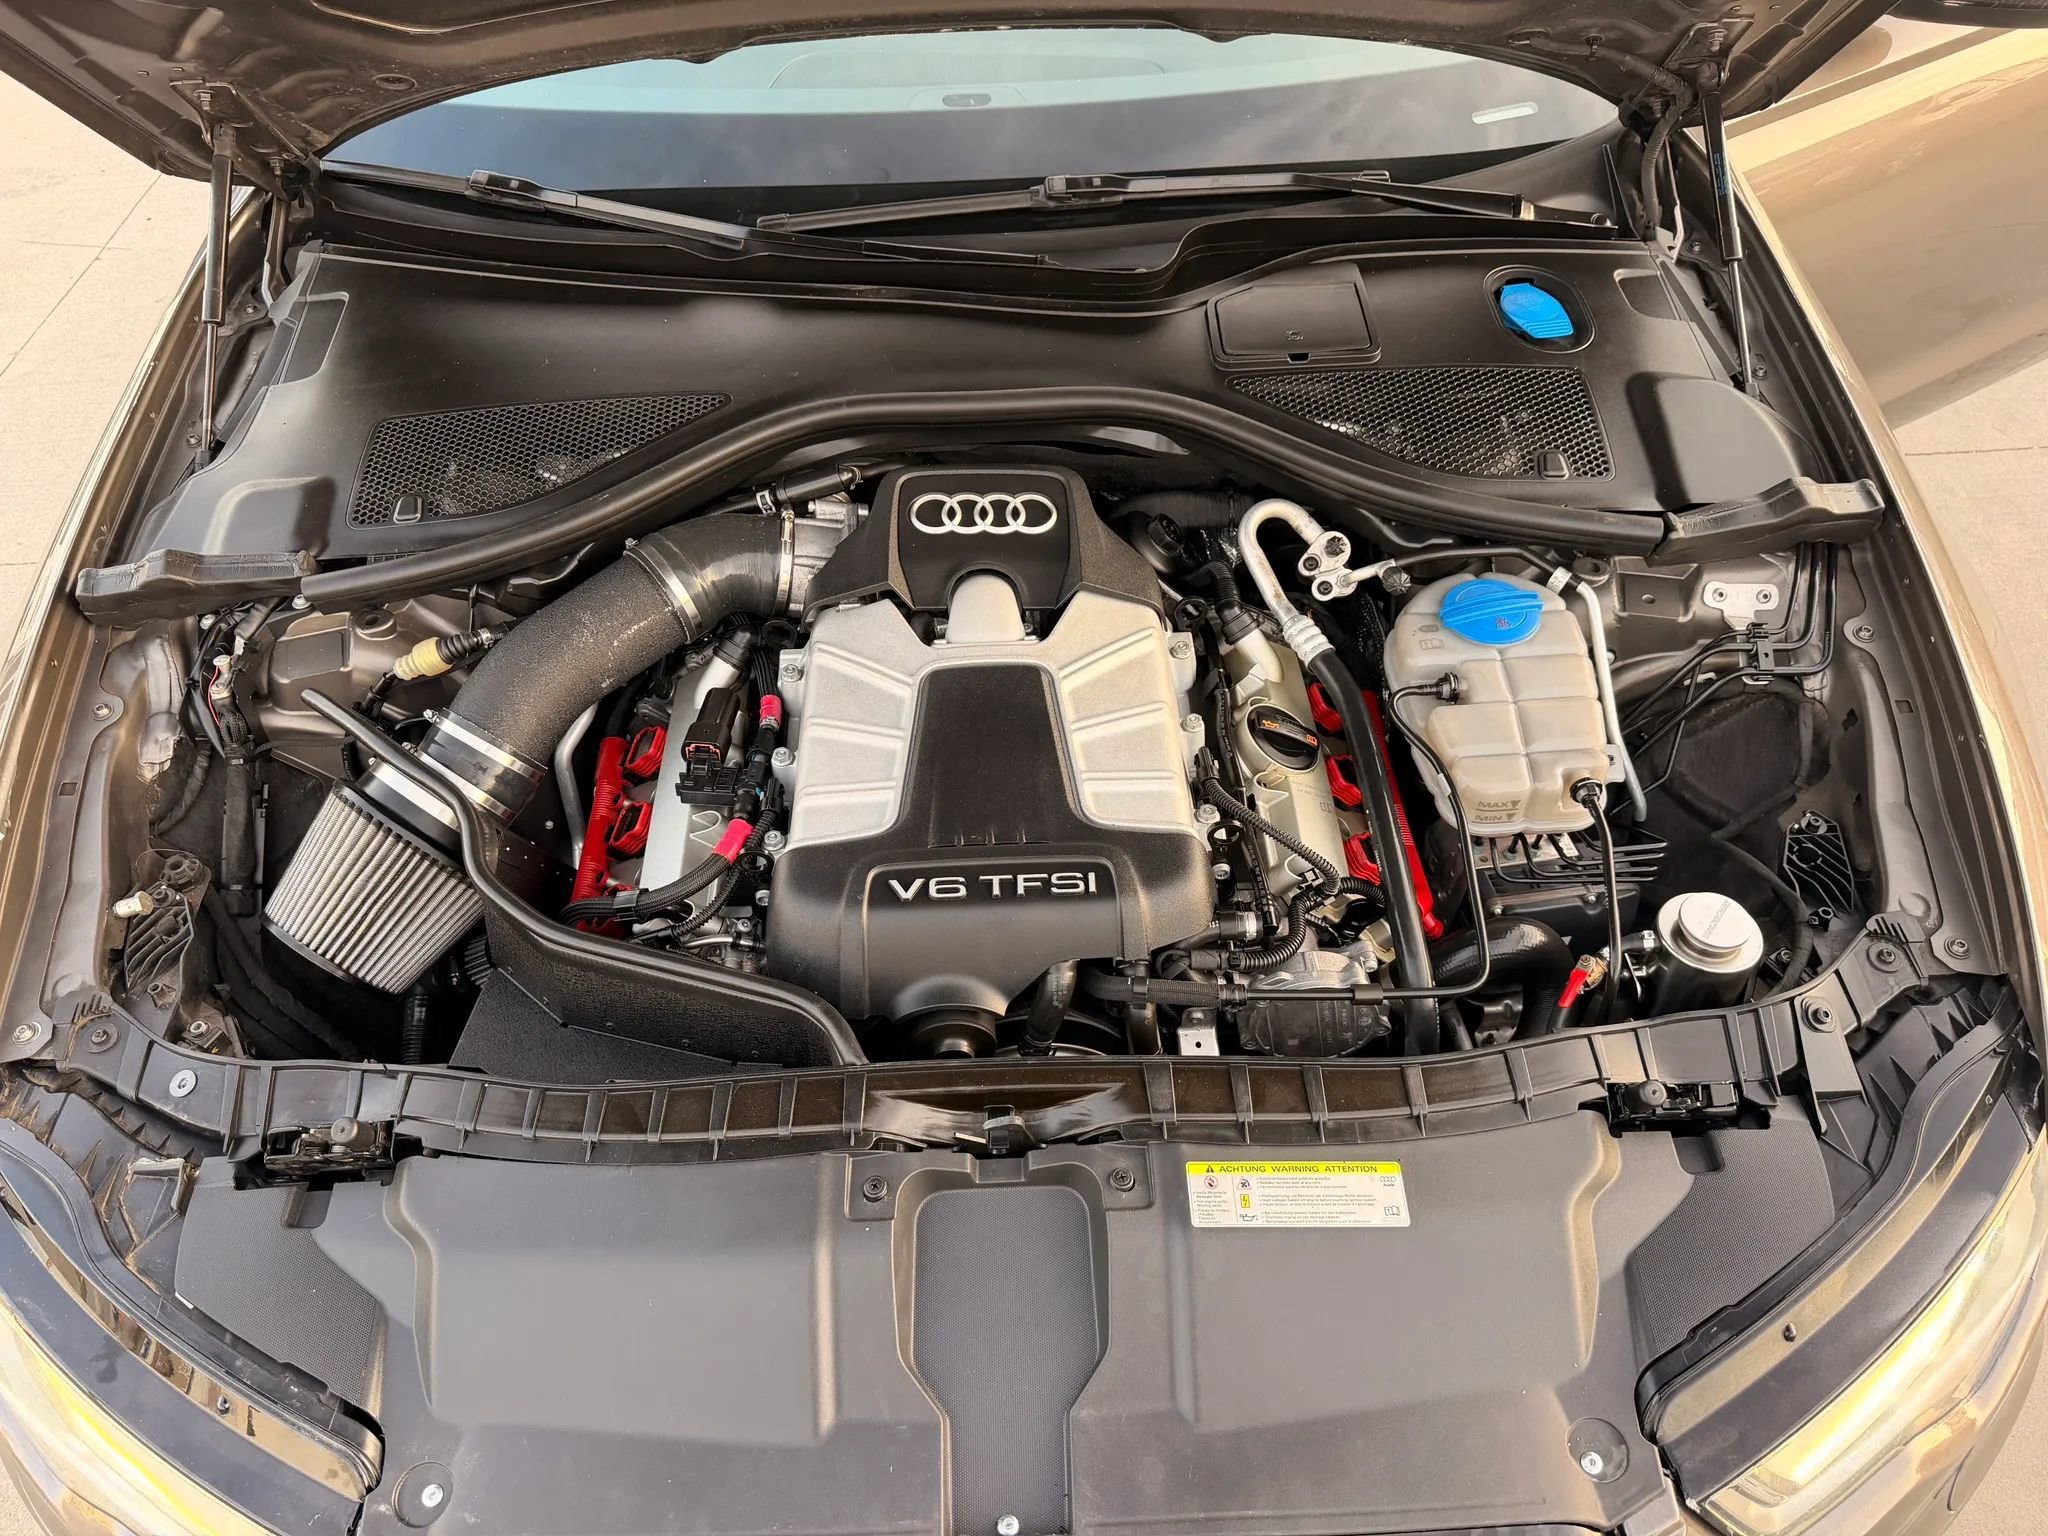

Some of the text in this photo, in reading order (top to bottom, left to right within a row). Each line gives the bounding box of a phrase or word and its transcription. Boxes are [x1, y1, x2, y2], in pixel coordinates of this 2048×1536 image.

[1478, 800, 1509, 808] MAX
[888, 871, 1098, 902] V6 TFSI
[1219, 1165, 1378, 1173] ACHTUNG WARNING ATTENTION
